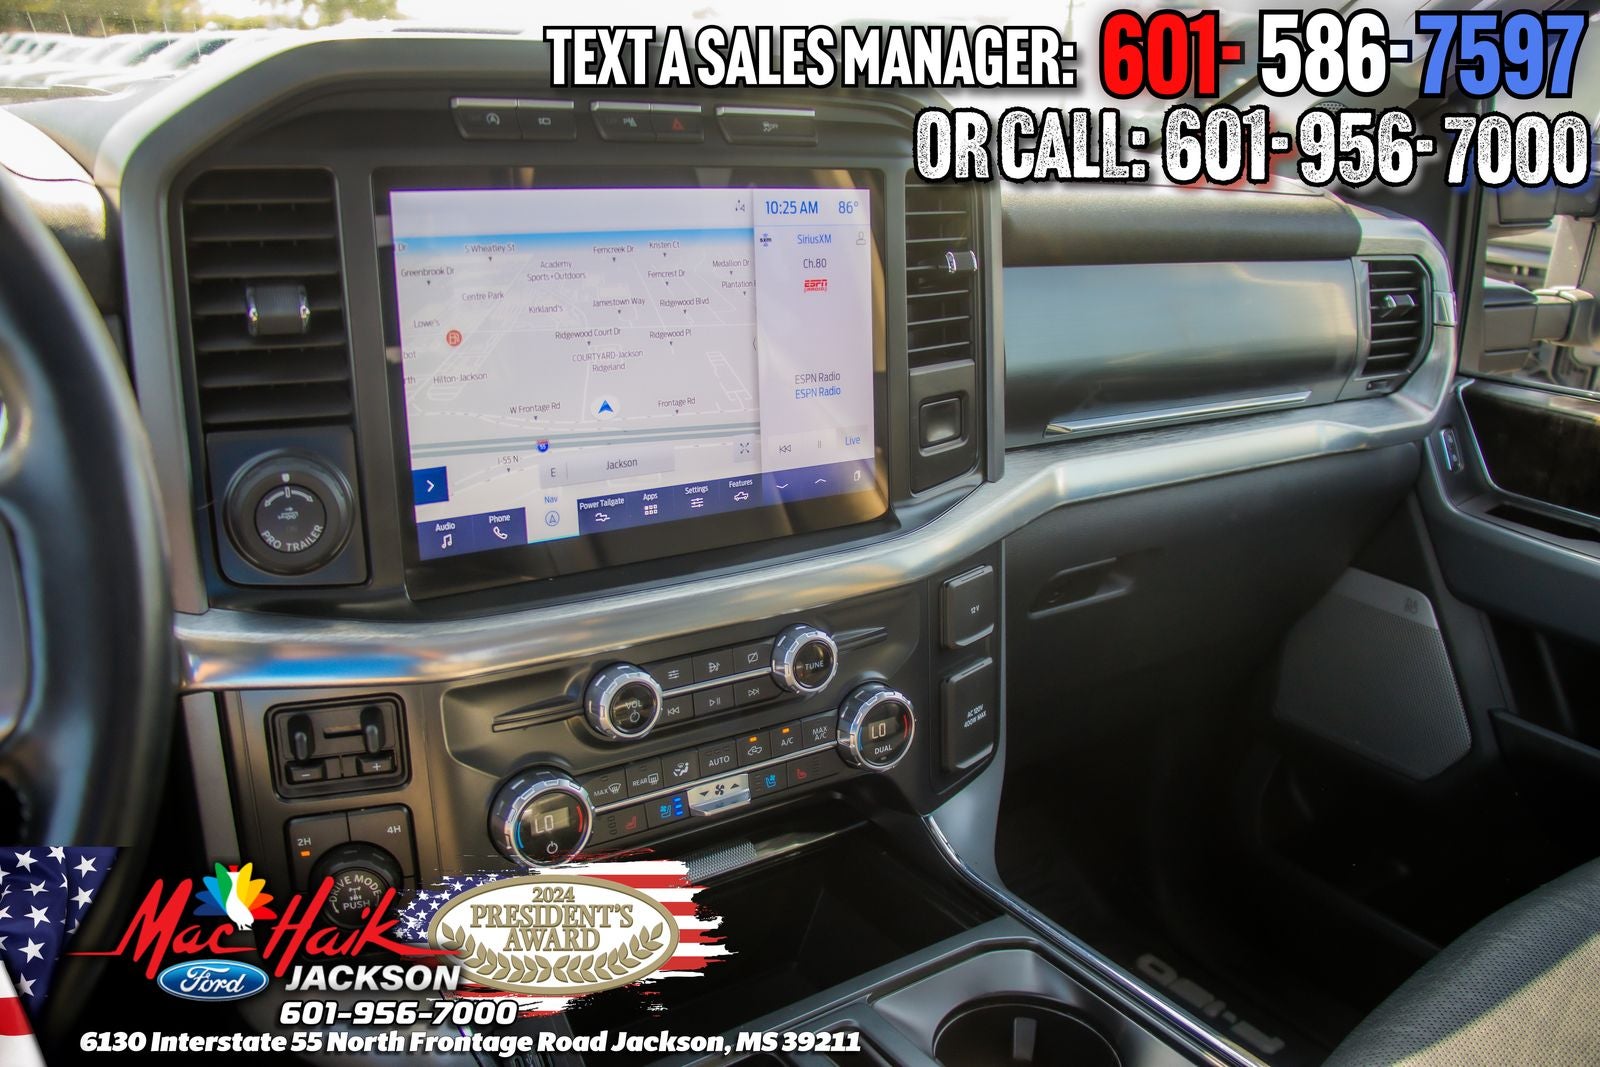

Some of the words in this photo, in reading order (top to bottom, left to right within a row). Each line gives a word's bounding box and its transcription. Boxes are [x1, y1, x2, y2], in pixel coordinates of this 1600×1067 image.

[766, 201, 797, 215] 10:25
[800, 201, 818, 214] AM
[649, 241, 674, 249] Kristen
[797, 234, 832, 245] SiriusXM
[471, 244, 505, 254] Wheatley
[593, 246, 625, 255] Ferncreek
[540, 260, 572, 269] Academy
[713, 260, 740, 268] Medallion
[742, 259, 750, 267] Dr
[803, 258, 827, 269] Ch.80
[401, 268, 444, 277] Greenbrook
[446, 267, 454, 275] Dr
[647, 270, 677, 279] Ferncrest
[722, 281, 752, 289] Plantation
[804, 279, 828, 287] ESPN
[488, 292, 504, 300] Park
[592, 298, 629, 308] Jamestown
[631, 297, 645, 305] Way
[659, 298, 694, 308] Ridgewood
[695, 297, 709, 305] Blvd
[528, 304, 563, 313] Kirkland's
[413, 319, 440, 329] Lowe's
[555, 330, 593, 340] Ridgewood
[594, 328, 612, 337] Court
[613, 327, 621, 336] Dr
[649, 329, 683, 340] Ridgewood
[592, 362, 626, 373] Ridgeland
[795, 373, 817, 384] ESPN
[818, 371, 841, 383] Radio
[795, 388, 817, 399] ESPN
[819, 385, 841, 397] Radio
[657, 399, 687, 409] Frontage
[688, 396, 696, 406] Rd
[509, 406, 517, 415] W
[518, 404, 549, 414] Frontage
[551, 402, 561, 411] Rd
[845, 436, 861, 446] Live
[513, 455, 519, 463] N
[606, 457, 638, 471] Jackson
[550, 467, 557, 477] E
[728, 478, 753, 489] Features
[685, 485, 709, 496] Settings
[544, 496, 558, 504] Nav
[643, 492, 658, 502] Apps
[579, 500, 600, 510] Power
[600, 497, 625, 507] Tailgate
[488, 513, 511, 525] Phone
[435, 522, 456, 533] Audio
[261, 530, 282, 550] PRO
[286, 524, 324, 552] TRAILER
[805, 660, 824, 671] TUNE
[625, 699, 642, 709] VOL
[812, 726, 828, 736] MAX
[780, 736, 795, 747] A/C
[814, 732, 827, 742] A/C
[874, 744, 893, 755] DUAL
[708, 755, 730, 767] AUTO
[632, 777, 648, 788] REAR
[593, 788, 609, 798] MAX
[386, 825, 401, 834] 4H
[297, 837, 311, 847] 2H
[329, 875, 352, 903] DRIVE
[354, 874, 382, 897] MODE
[343, 900, 371, 911] PUSH
